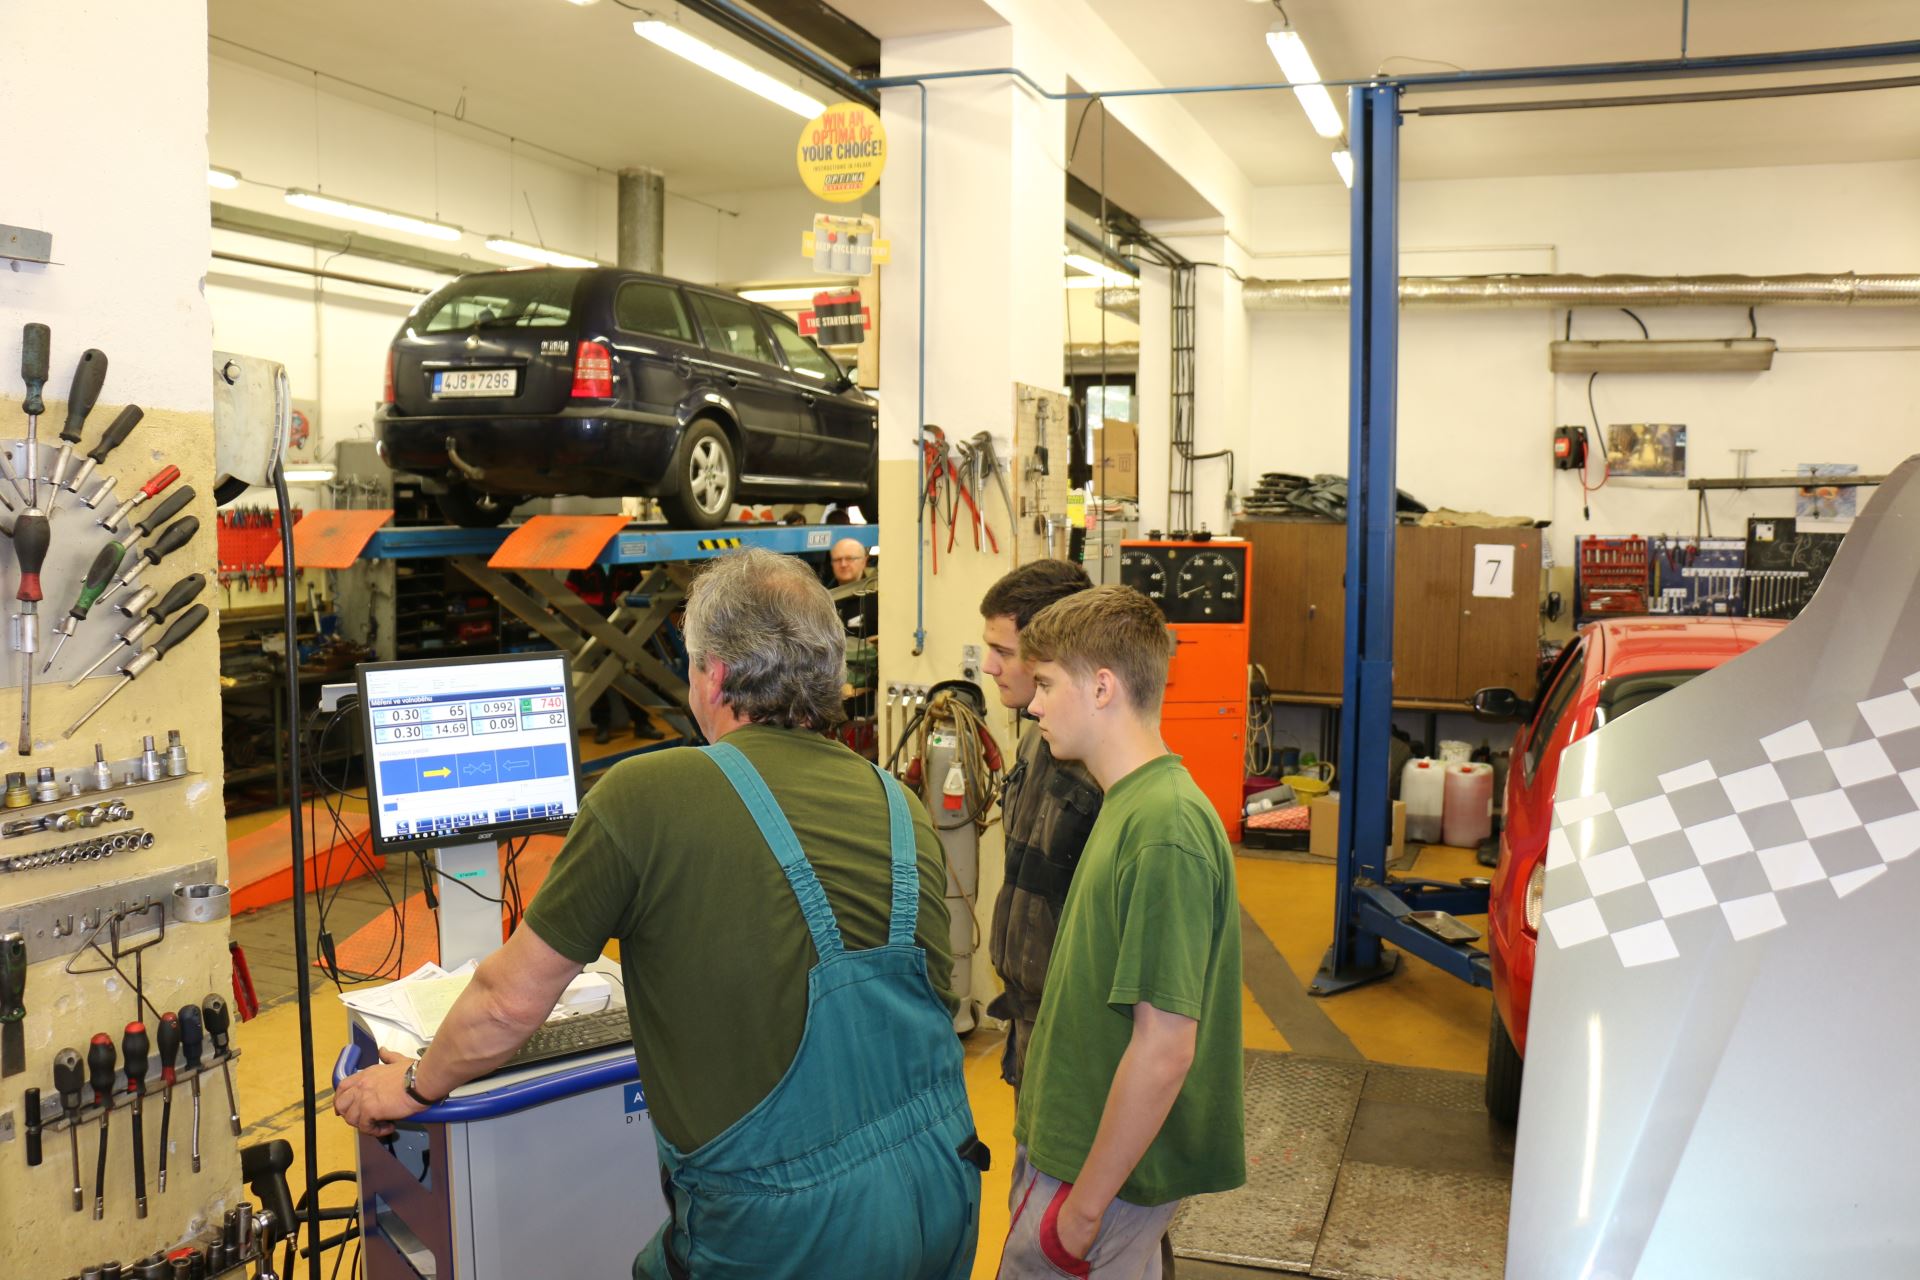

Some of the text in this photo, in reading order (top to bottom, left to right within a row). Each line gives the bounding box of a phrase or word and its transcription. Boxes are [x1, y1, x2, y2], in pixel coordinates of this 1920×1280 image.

[822, 112, 845, 129] WIN
[812, 127, 855, 145] OPTIMA
[802, 139, 882, 162] YOUR CHOICE!
[806, 317, 820, 328] THE
[445, 374, 467, 389] 4J8
[478, 373, 509, 389] 7296
[1486, 560, 1501, 584] 7
[483, 701, 513, 713] 0.992
[541, 697, 562, 708] 740
[392, 709, 419, 721] 0.30
[449, 705, 465, 717] 65
[490, 717, 515, 730] 0.09
[549, 713, 563, 725] 82
[394, 726, 421, 739] 0.30
[436, 722, 466, 735] 14.69
